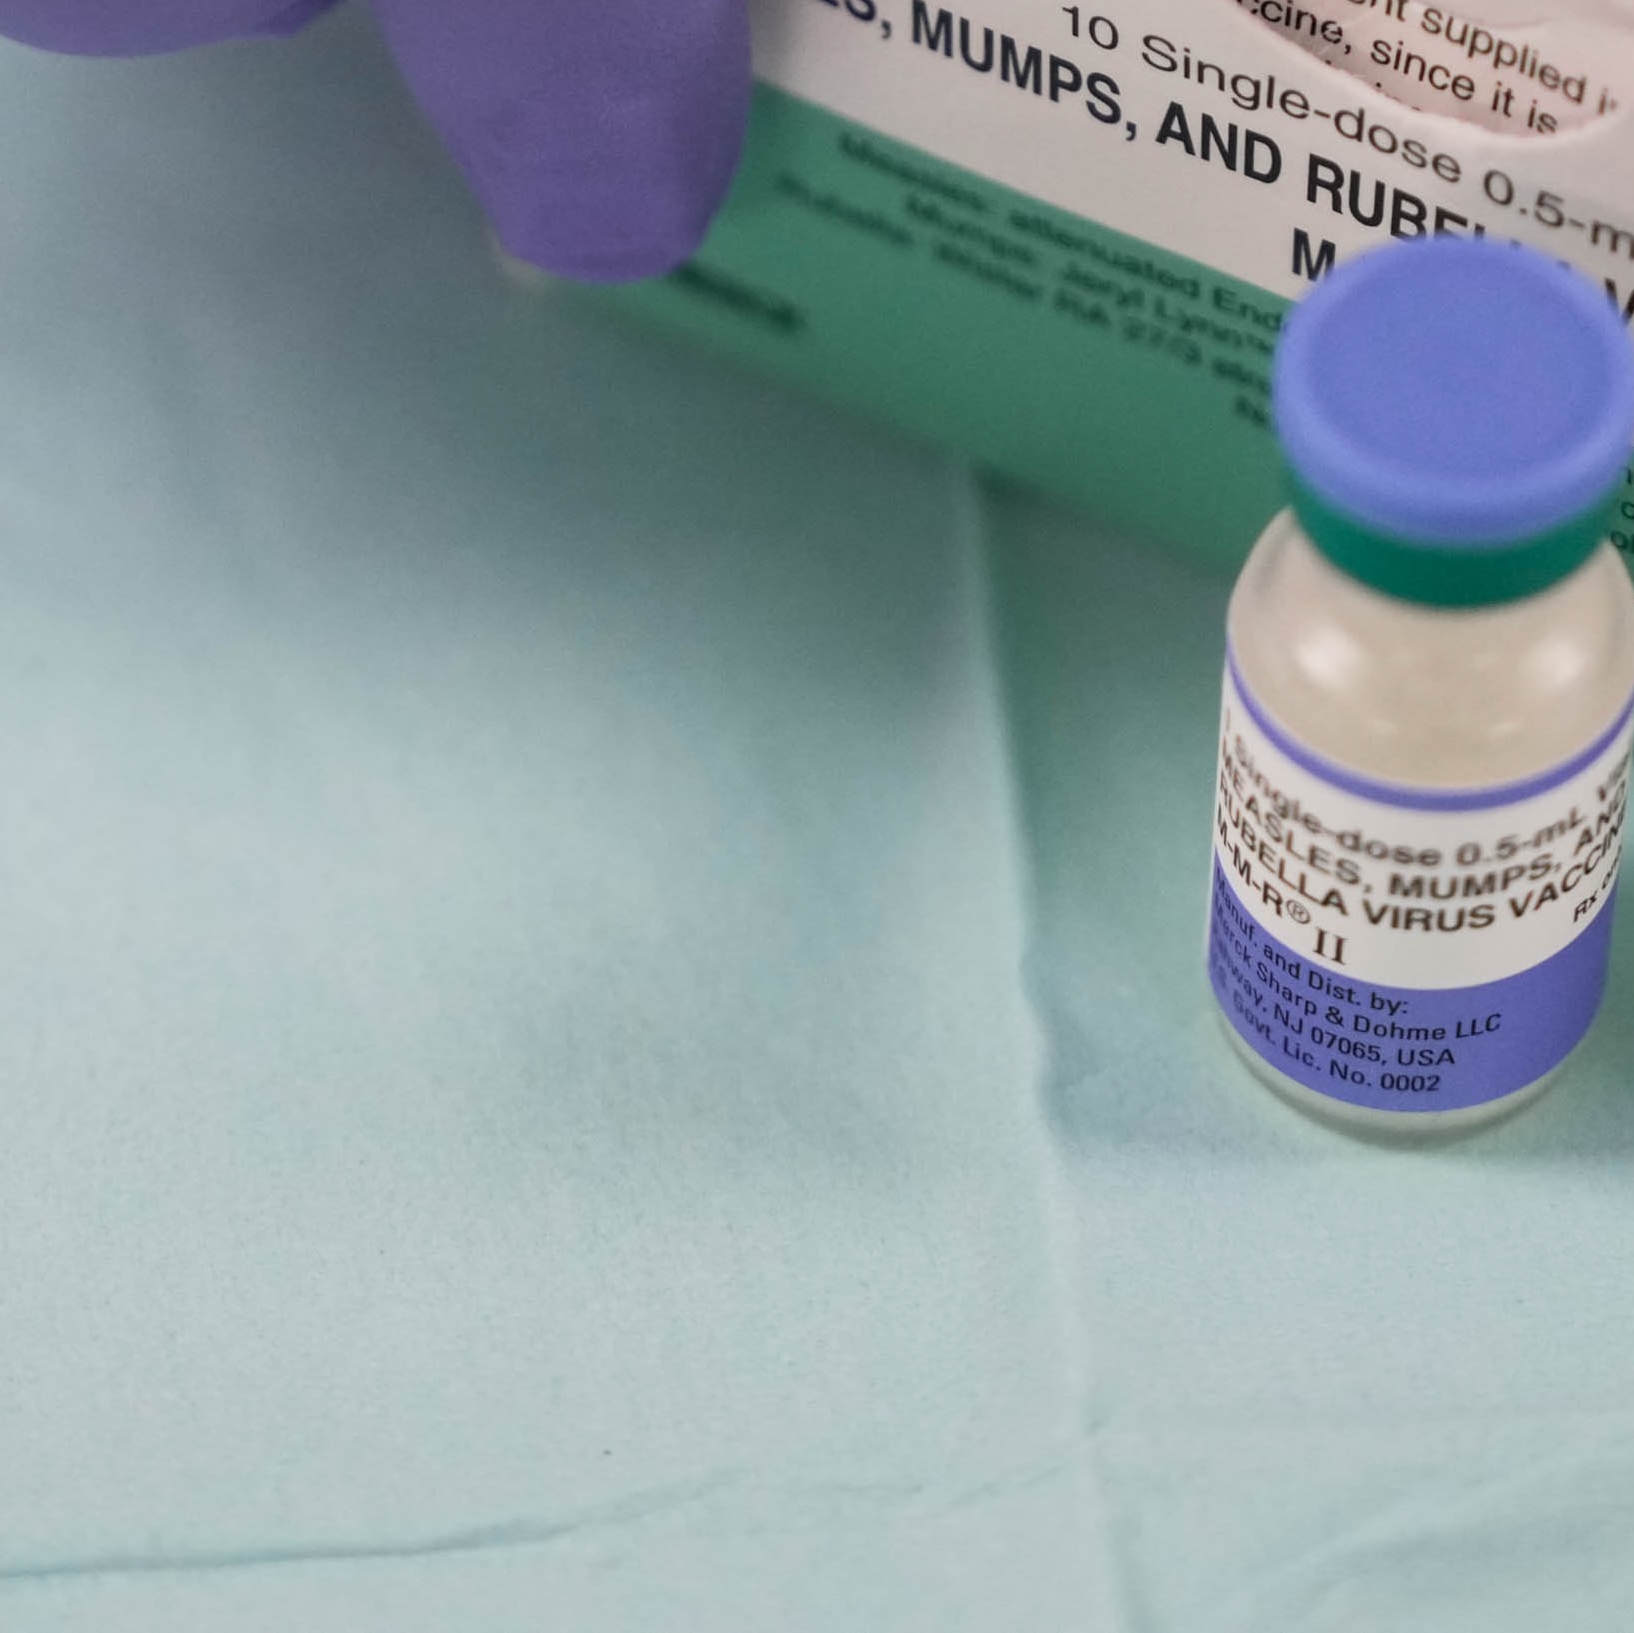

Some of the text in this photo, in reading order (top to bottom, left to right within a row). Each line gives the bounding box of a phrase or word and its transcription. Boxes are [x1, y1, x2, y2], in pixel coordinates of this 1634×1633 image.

[1061, 5, 1120, 51] 10
[1140, 33, 1462, 184] Single-dose
[1369, 37, 1475, 102] since
[1491, 80, 1513, 118] it
[1527, 99, 1558, 135] is
[1419, 6, 1588, 105] supplied
[1155, 100, 1282, 186] AND
[1219, 768, 1349, 917] RUBELLA
[1362, 897, 1496, 934] VIRUS
[1262, 942, 1301, 981] and
[1308, 970, 1362, 1007] Dist.
[1370, 991, 1409, 1017] by:
[1312, 925, 1349, 966] II
[1256, 959, 1317, 1016] Sharp
[1324, 1004, 1345, 1028] &
[1354, 1014, 1447, 1042] Dohme
[1455, 1012, 1502, 1040] LLC
[1274, 999, 1304, 1036] NJ
[1310, 1025, 1388, 1066] 07065,
[1397, 1047, 1456, 1068] USA
[1283, 1034, 1321, 1072] Lic.
[1329, 1057, 1371, 1087] No.
[1379, 1072, 1441, 1093] 0002
